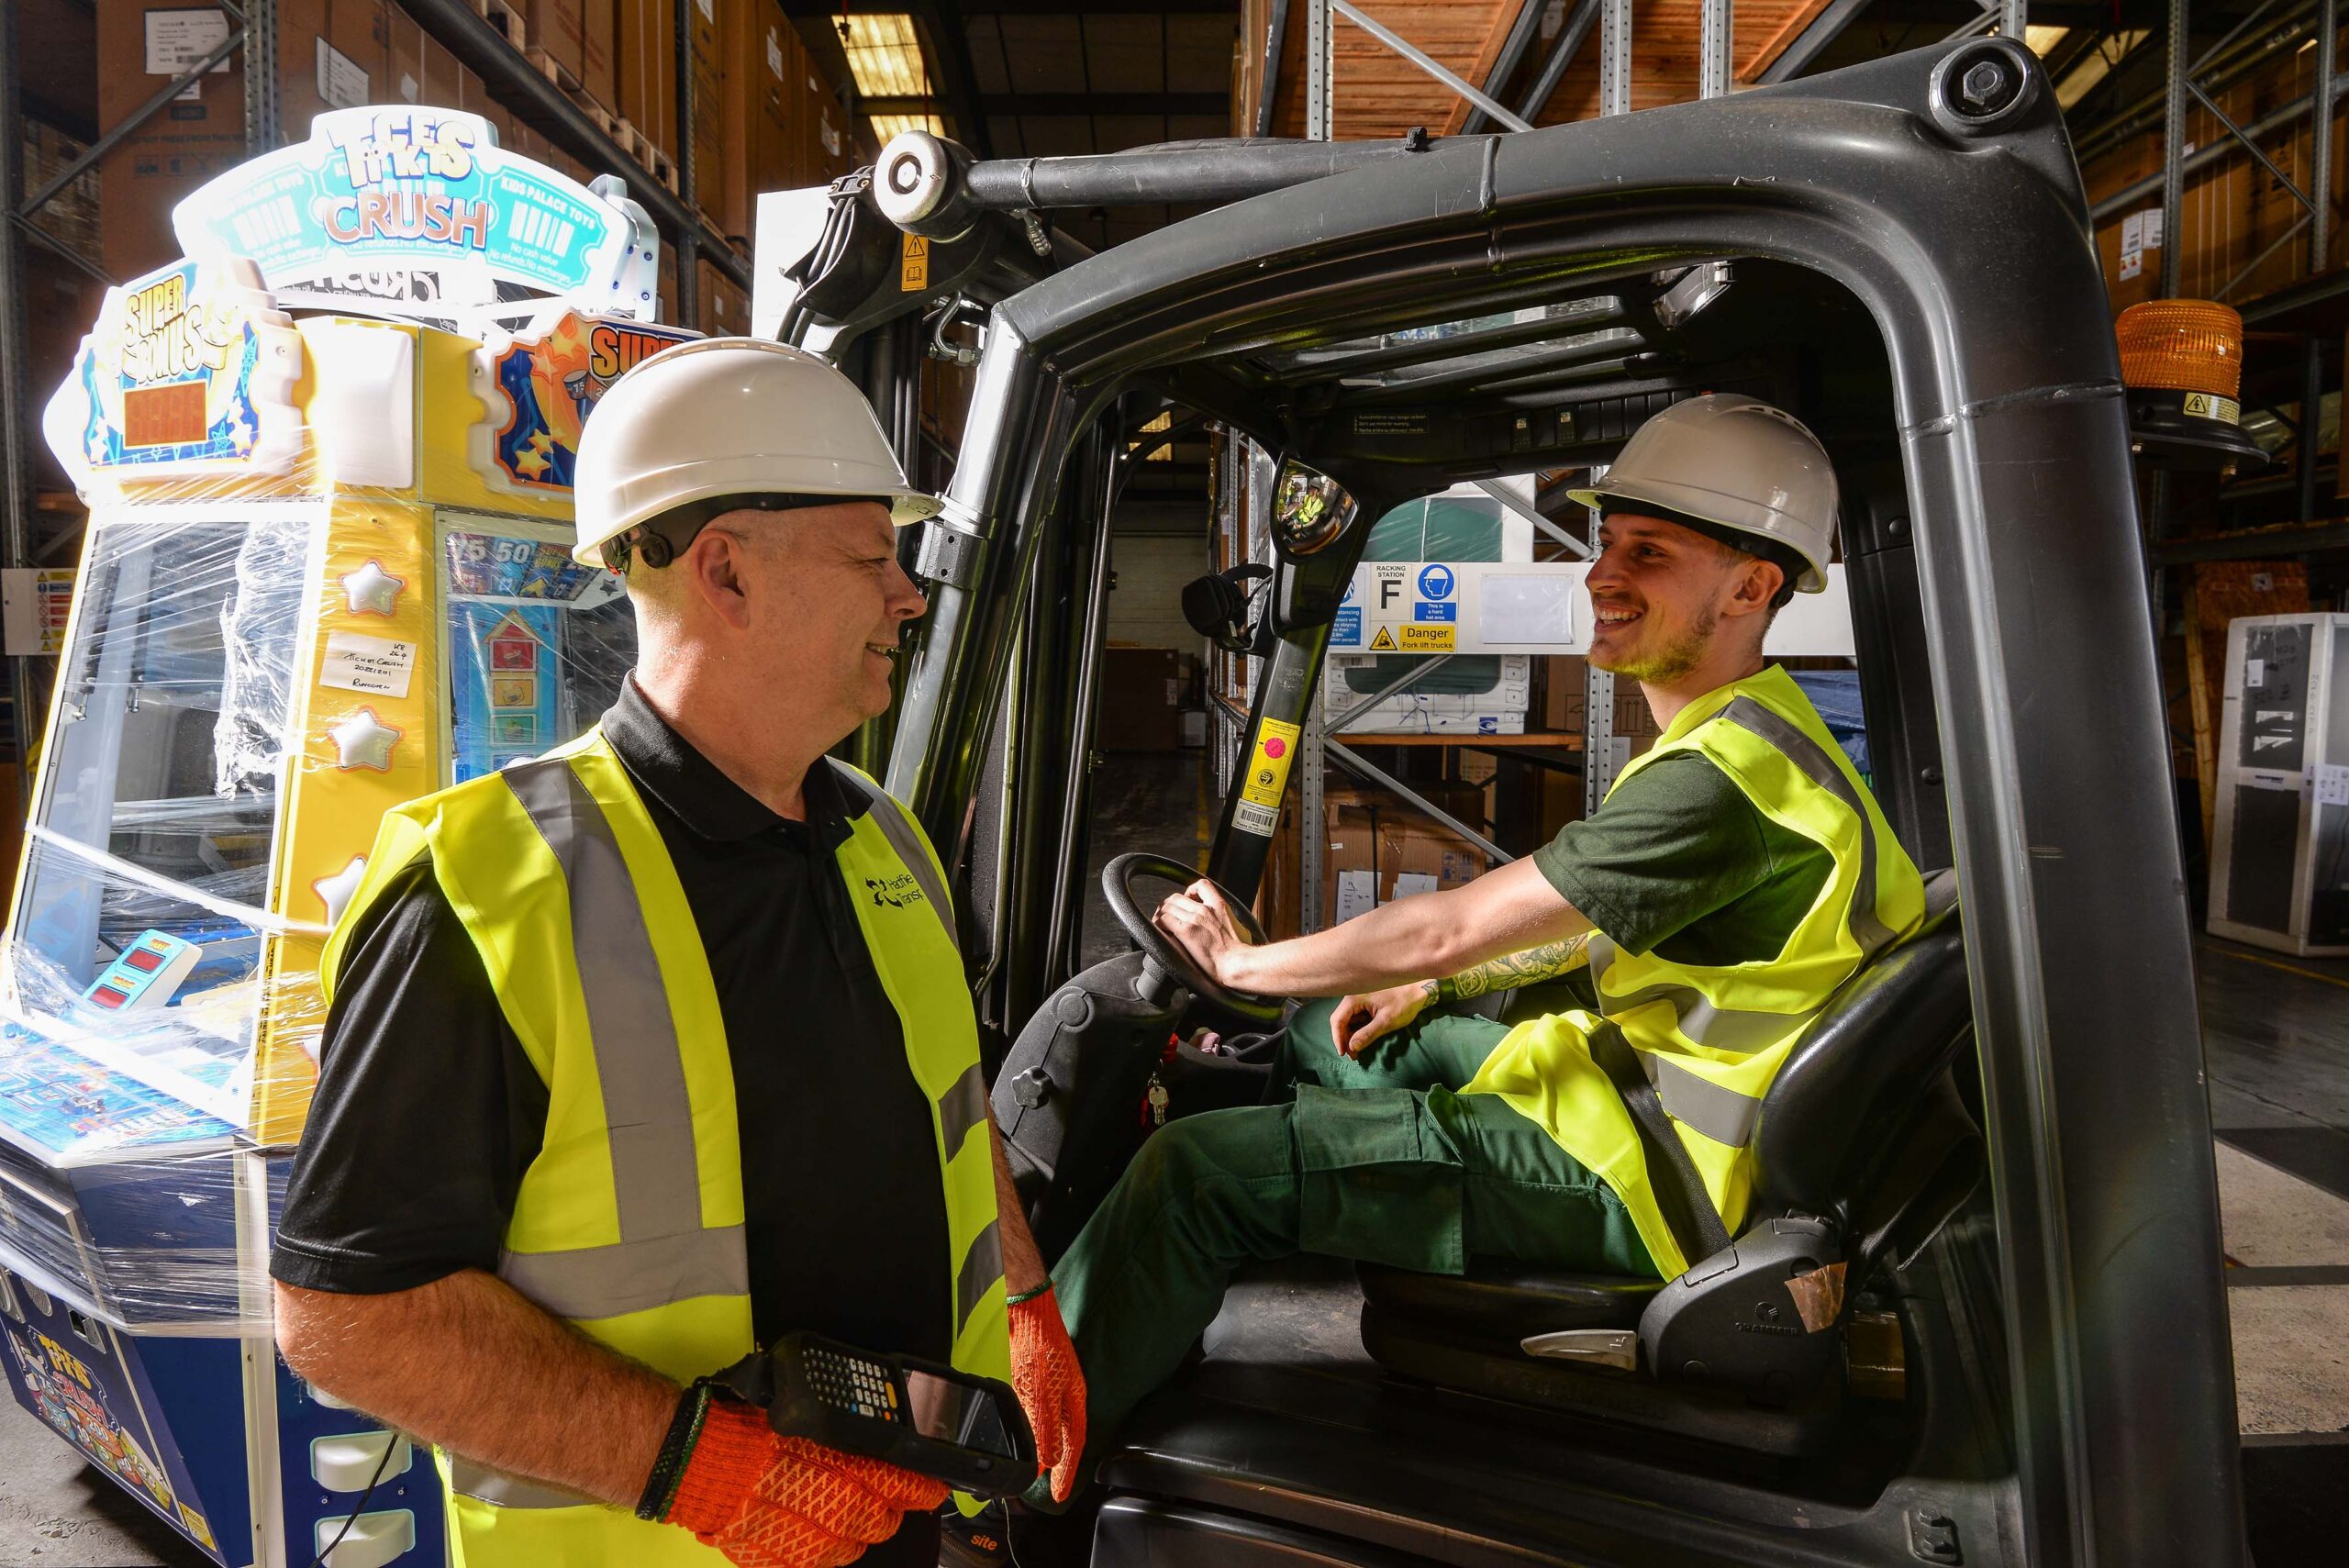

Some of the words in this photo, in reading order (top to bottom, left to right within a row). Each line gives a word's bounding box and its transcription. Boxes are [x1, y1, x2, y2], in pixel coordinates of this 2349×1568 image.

[500, 175, 527, 196] KIDS
[527, 186, 568, 215] PALACE
[569, 206, 597, 230] TOYS
[323, 190, 490, 250] CRUSH
[510, 242, 522, 254] No
[522, 245, 540, 259] cash
[540, 252, 559, 266] value
[126, 274, 184, 347] SUPER
[496, 540, 530, 564] 50
[1380, 579, 1402, 610] F
[1407, 628, 1449, 640] Danger
[86, 1418, 109, 1443] 200
[971, 1534, 997, 1551] site
